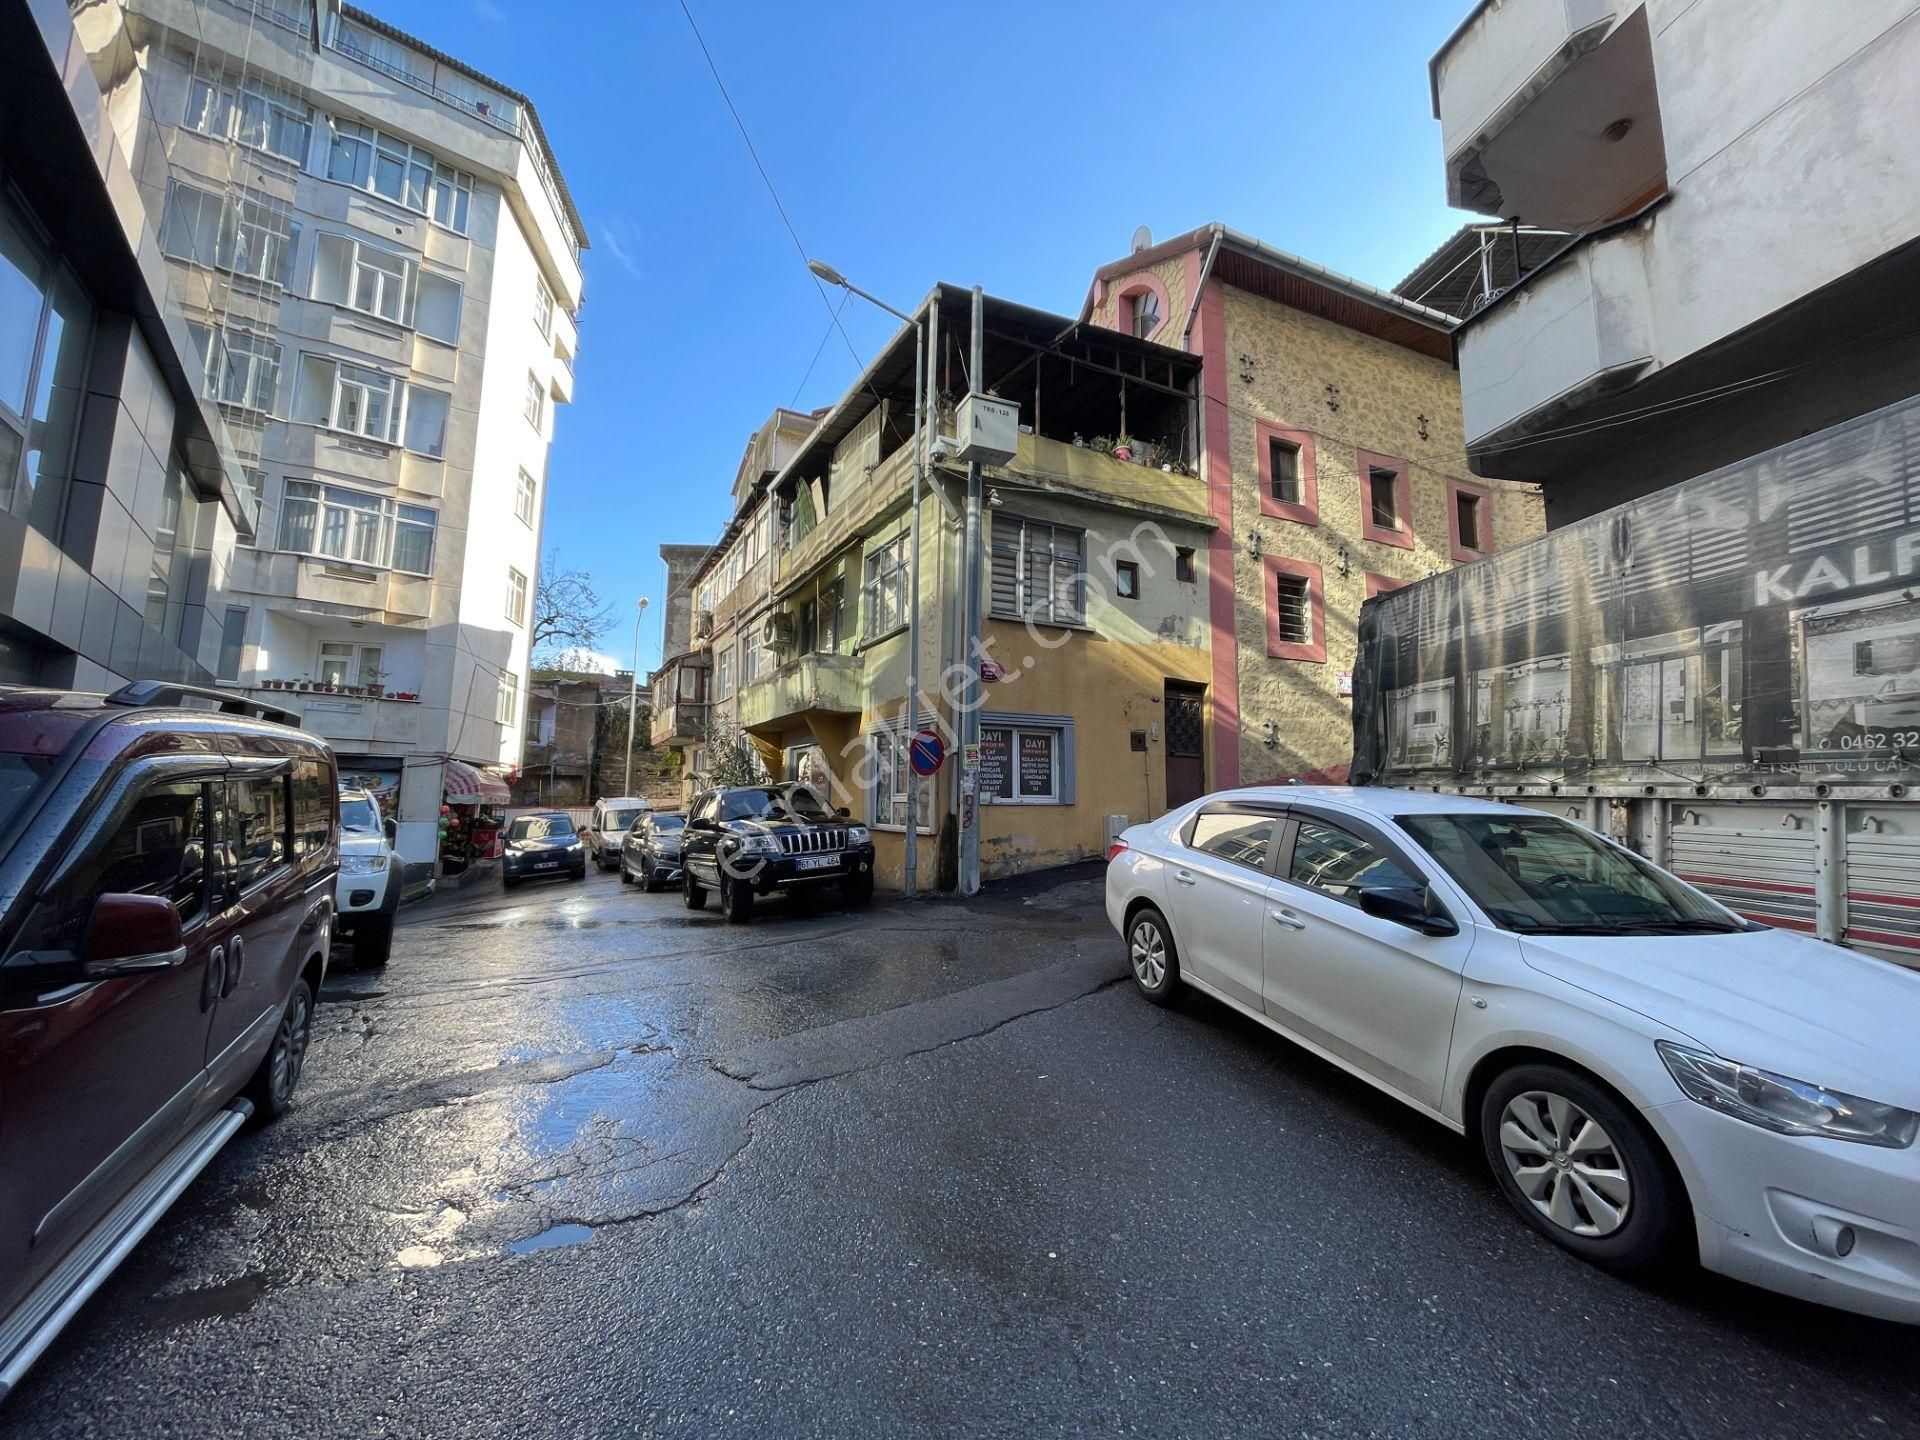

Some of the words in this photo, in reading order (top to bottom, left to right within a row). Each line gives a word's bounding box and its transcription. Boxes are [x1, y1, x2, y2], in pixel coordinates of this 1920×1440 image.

[1025, 739, 1045, 749] DAYI
[1841, 733, 1887, 750] 0462
[1893, 731, 1920, 748] 32
[1825, 761, 1869, 771] YOLU
[801, 860, 810, 868] 61
[813, 859, 823, 867] YL
